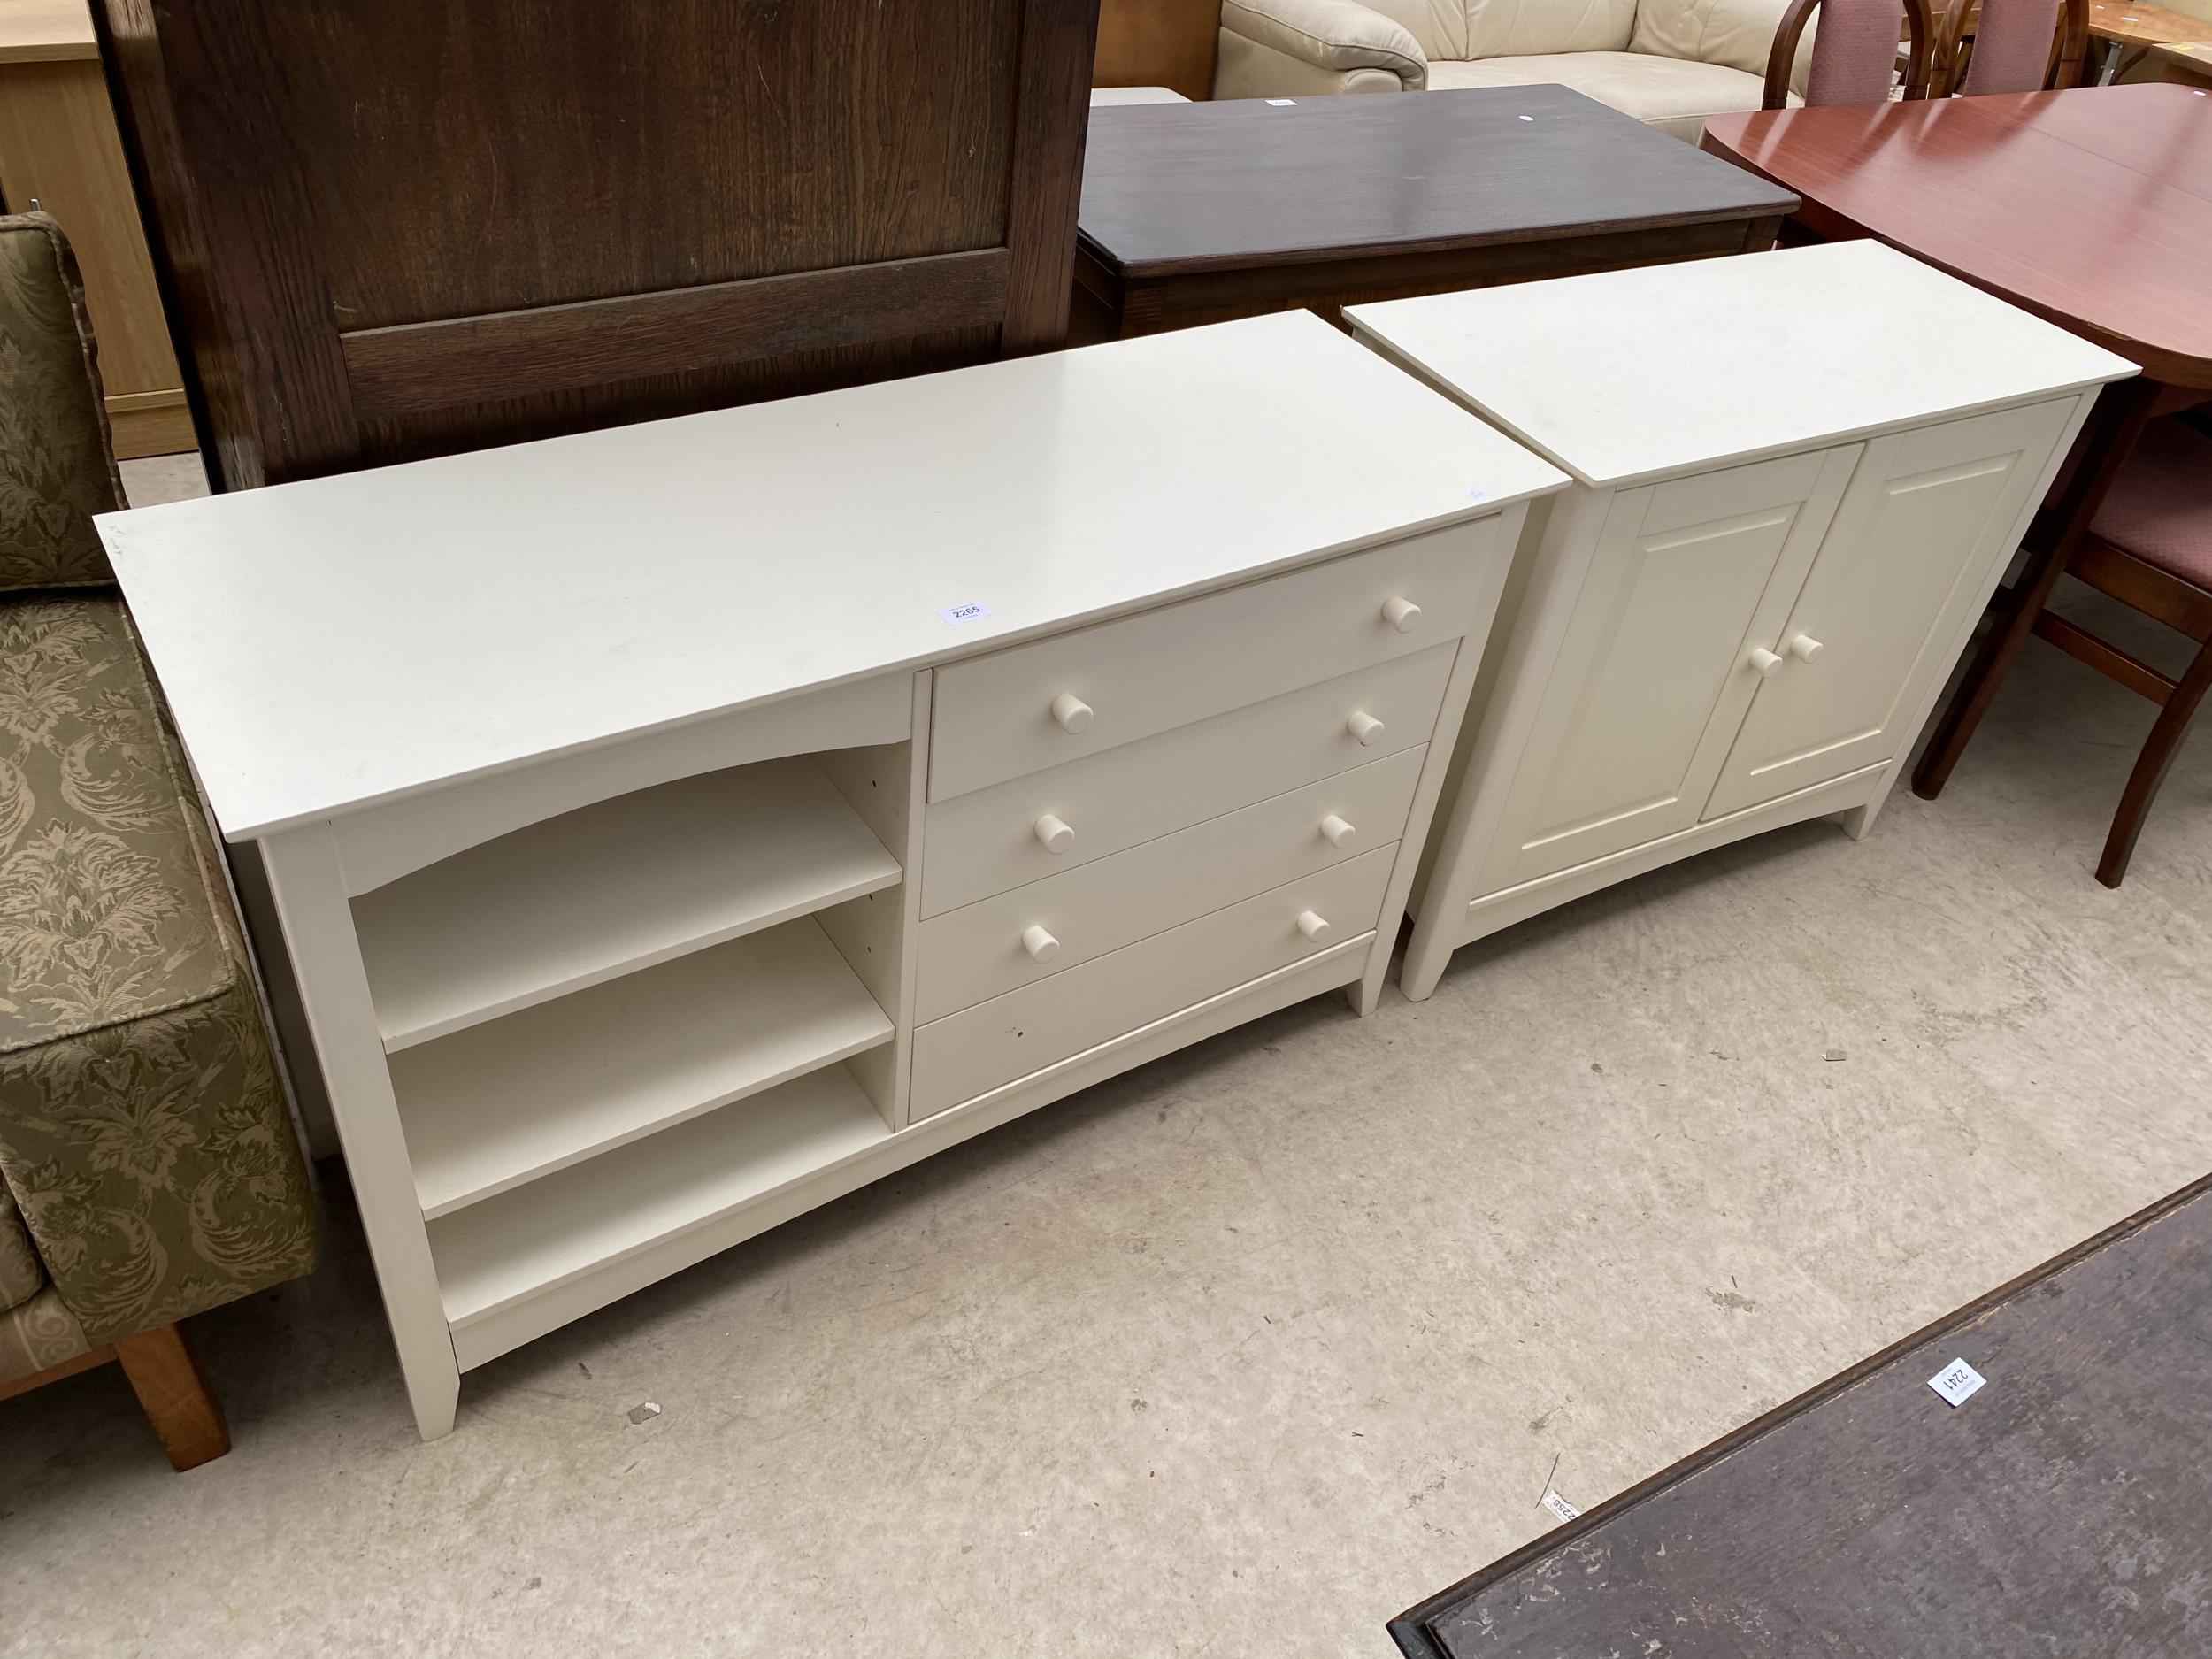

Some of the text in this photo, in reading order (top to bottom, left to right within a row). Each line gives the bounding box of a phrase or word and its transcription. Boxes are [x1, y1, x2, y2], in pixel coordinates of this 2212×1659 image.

[952, 606, 980, 618] 2265
[1943, 1369, 1969, 1390] 2241
[1553, 1499, 1576, 1520] 2258
